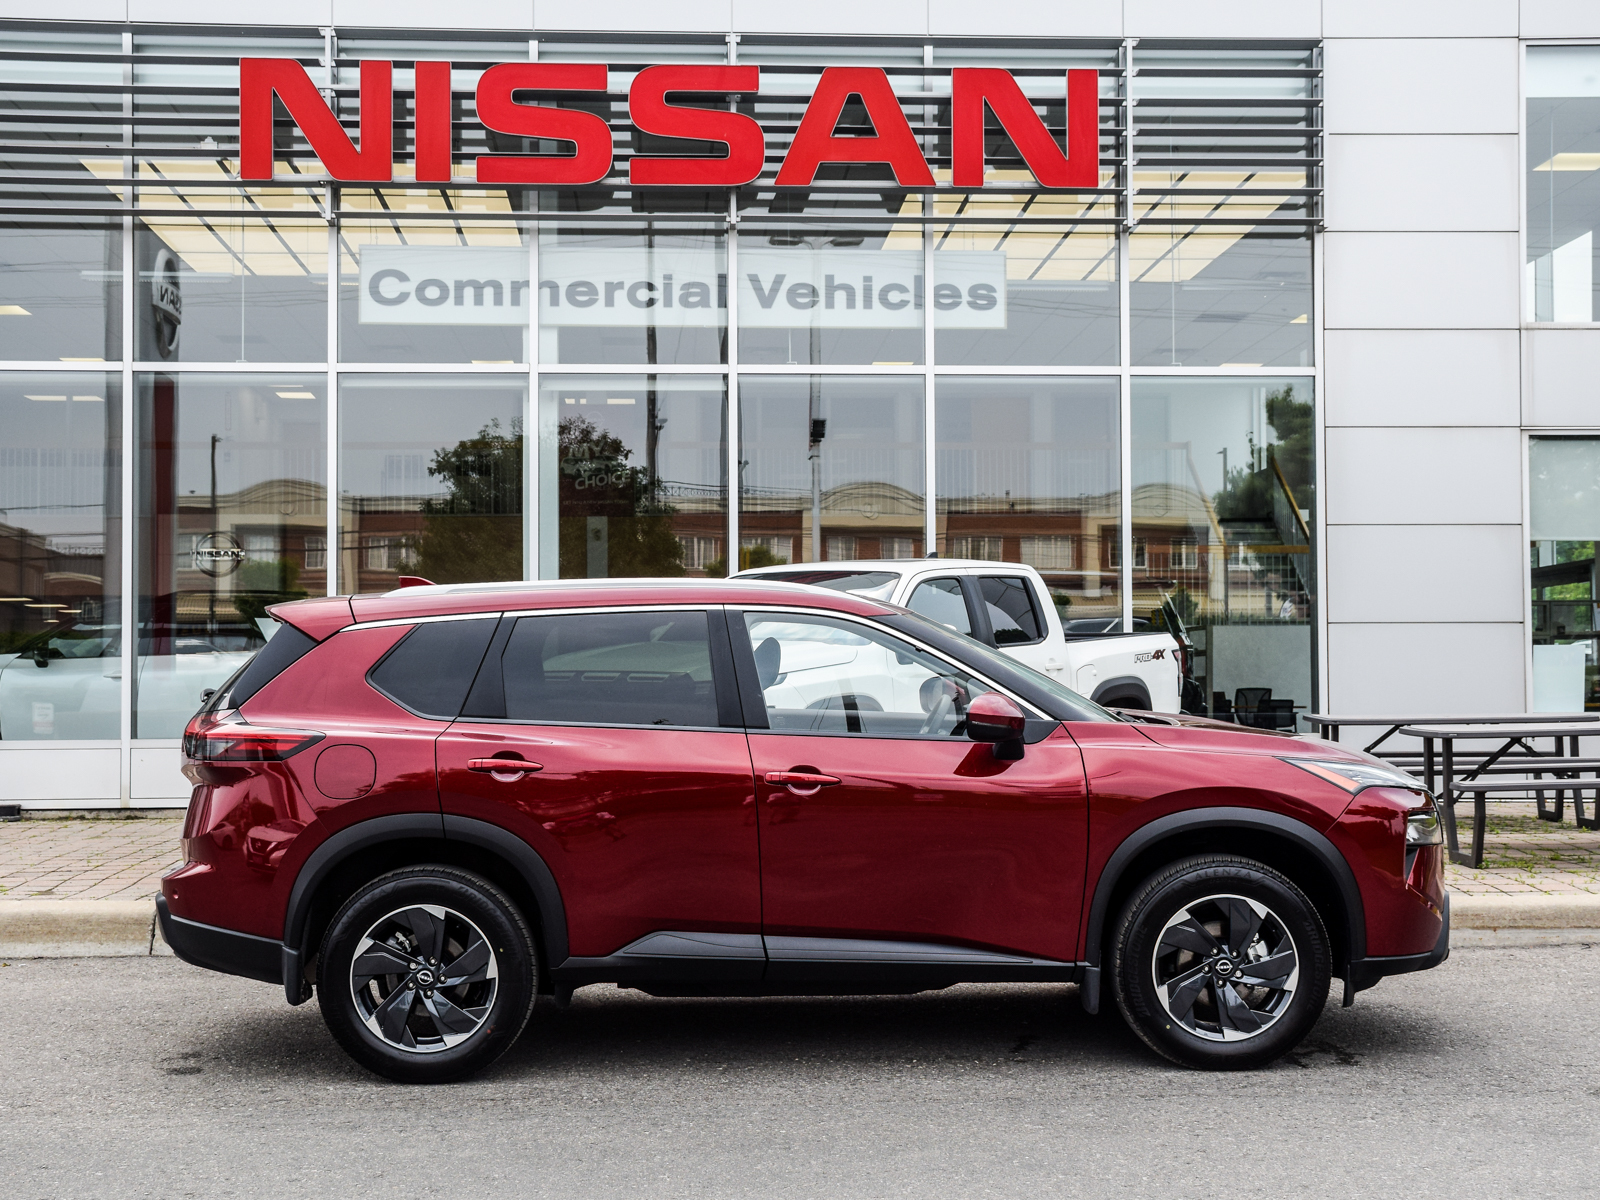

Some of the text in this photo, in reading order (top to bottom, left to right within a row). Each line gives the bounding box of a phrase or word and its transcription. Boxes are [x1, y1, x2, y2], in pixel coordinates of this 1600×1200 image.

[240, 57, 1099, 189] NISSAN
[369, 268, 998, 312] Commercial Vehicles
[574, 471, 631, 490] CHOICE
[196, 550, 240, 558] NISSAN
[1195, 867, 1252, 880] ALENZA
